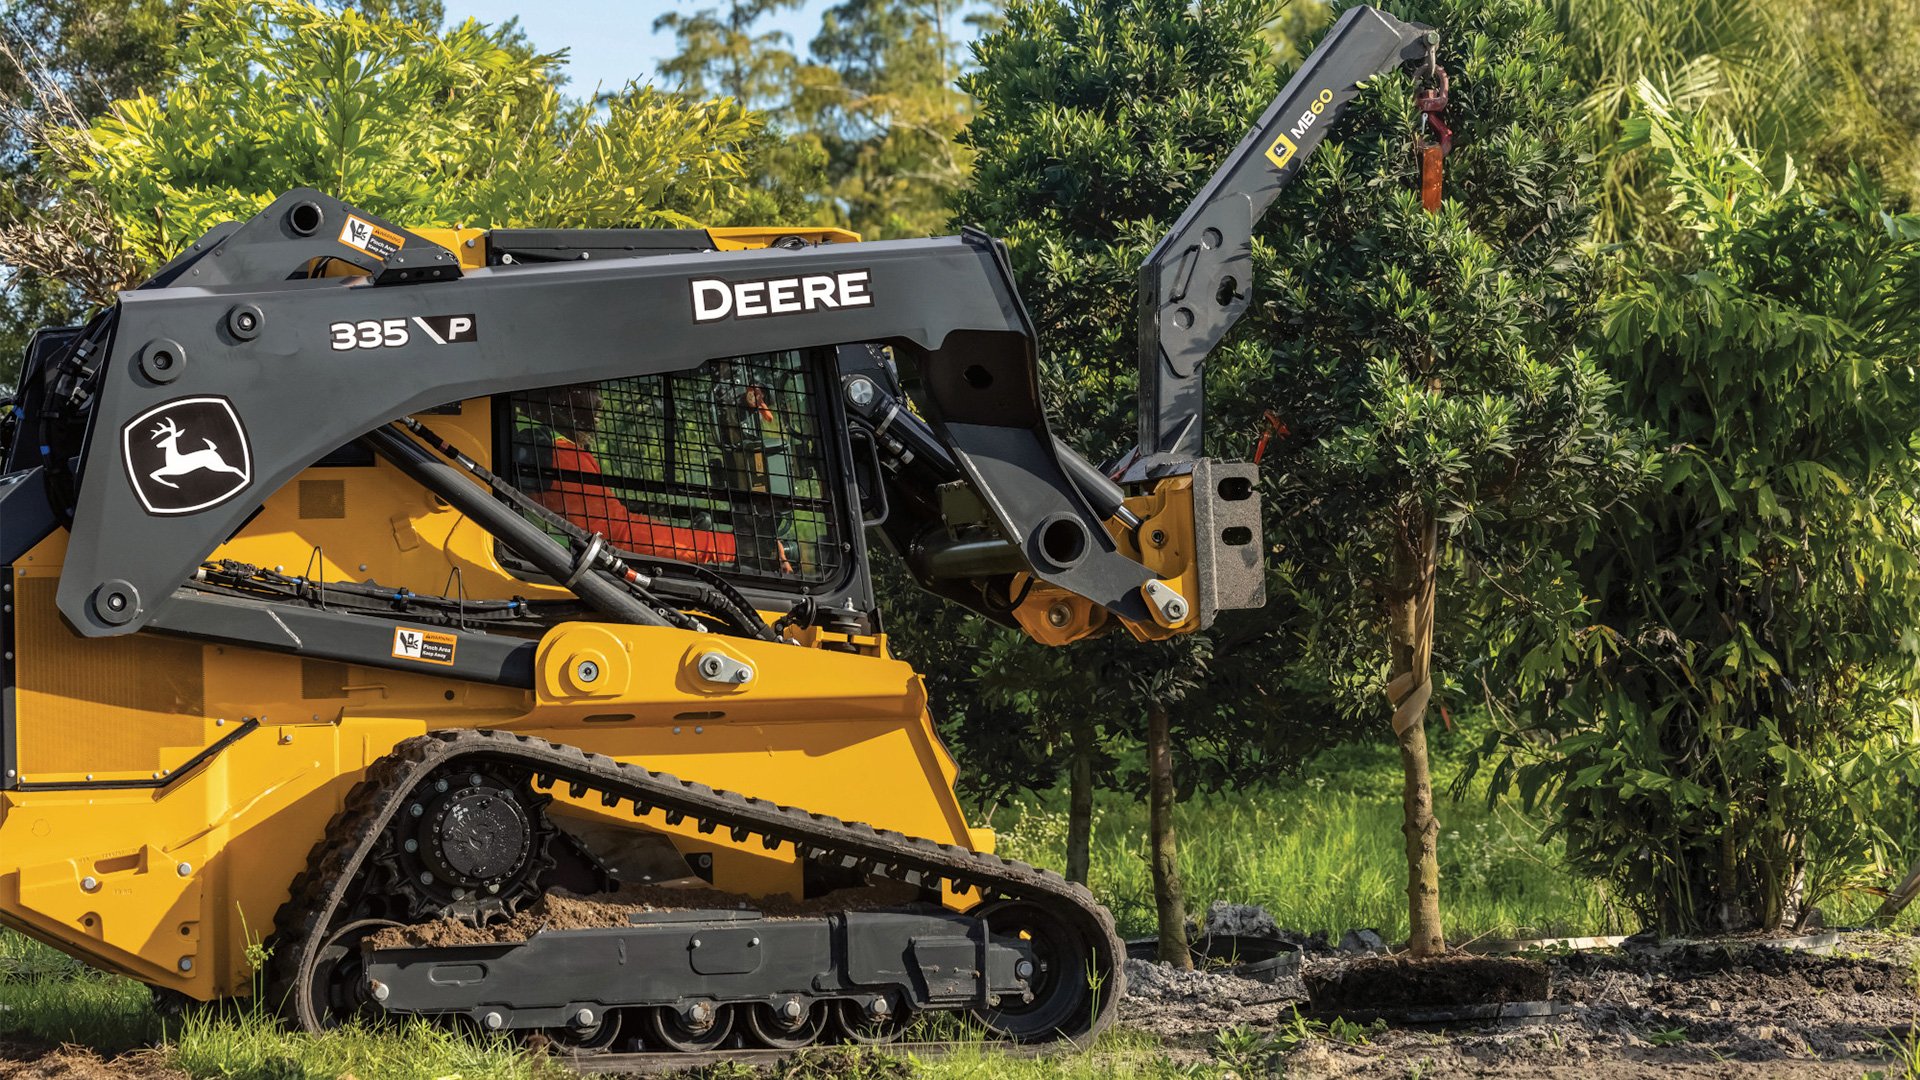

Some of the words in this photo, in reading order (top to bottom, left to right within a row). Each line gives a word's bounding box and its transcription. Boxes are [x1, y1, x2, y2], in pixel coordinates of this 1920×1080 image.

[1290, 88, 1334, 140] MB60
[368, 244, 379, 252] Keep
[370, 238, 384, 249] Pinch
[692, 271, 871, 321] DEERE
[331, 319, 409, 350] 335
